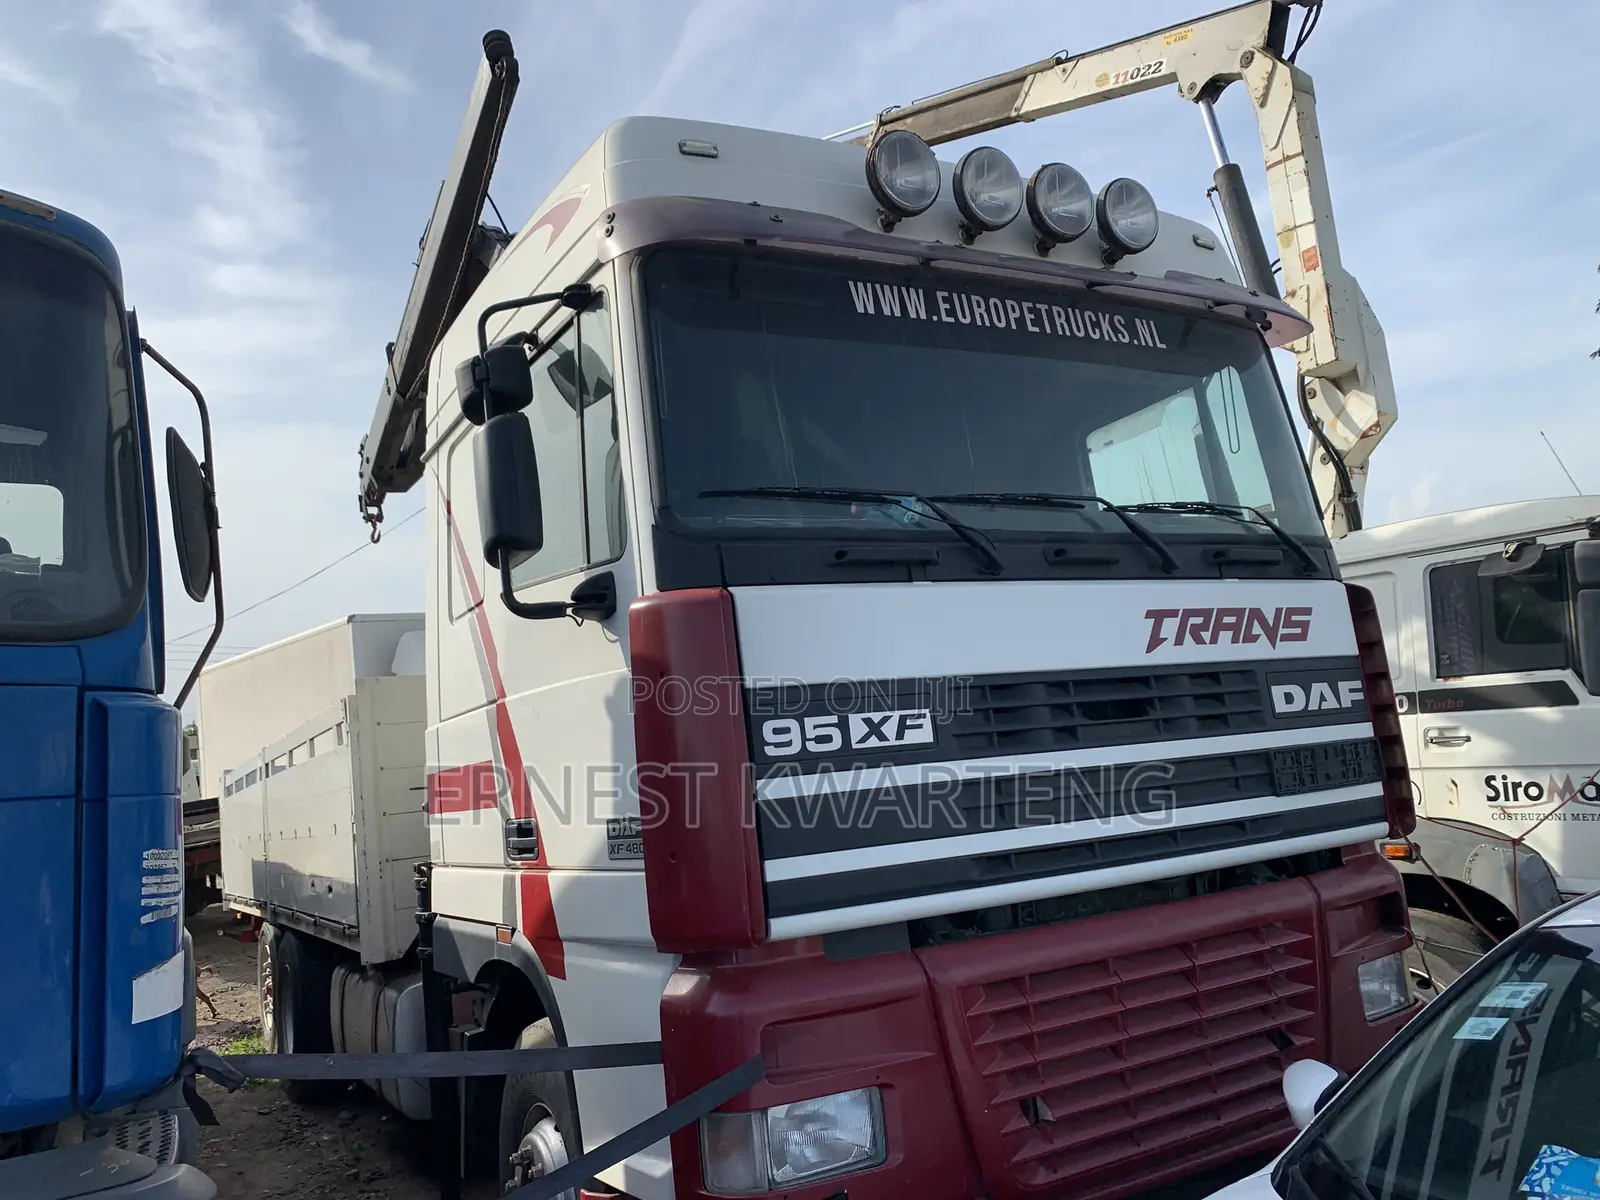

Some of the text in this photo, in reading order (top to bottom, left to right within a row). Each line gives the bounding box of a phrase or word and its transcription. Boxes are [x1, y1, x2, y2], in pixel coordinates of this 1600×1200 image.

[1112, 61, 1164, 85] 11022
[848, 280, 1167, 349] WWW.EUROPETRUCKS.NL
[1144, 606, 1313, 654] TRANS
[1271, 680, 1365, 714] DAF
[1424, 697, 1465, 710] Turbo
[762, 713, 928, 756] 95 XF
[609, 821, 642, 837] DAF
[609, 843, 624, 855] XF
